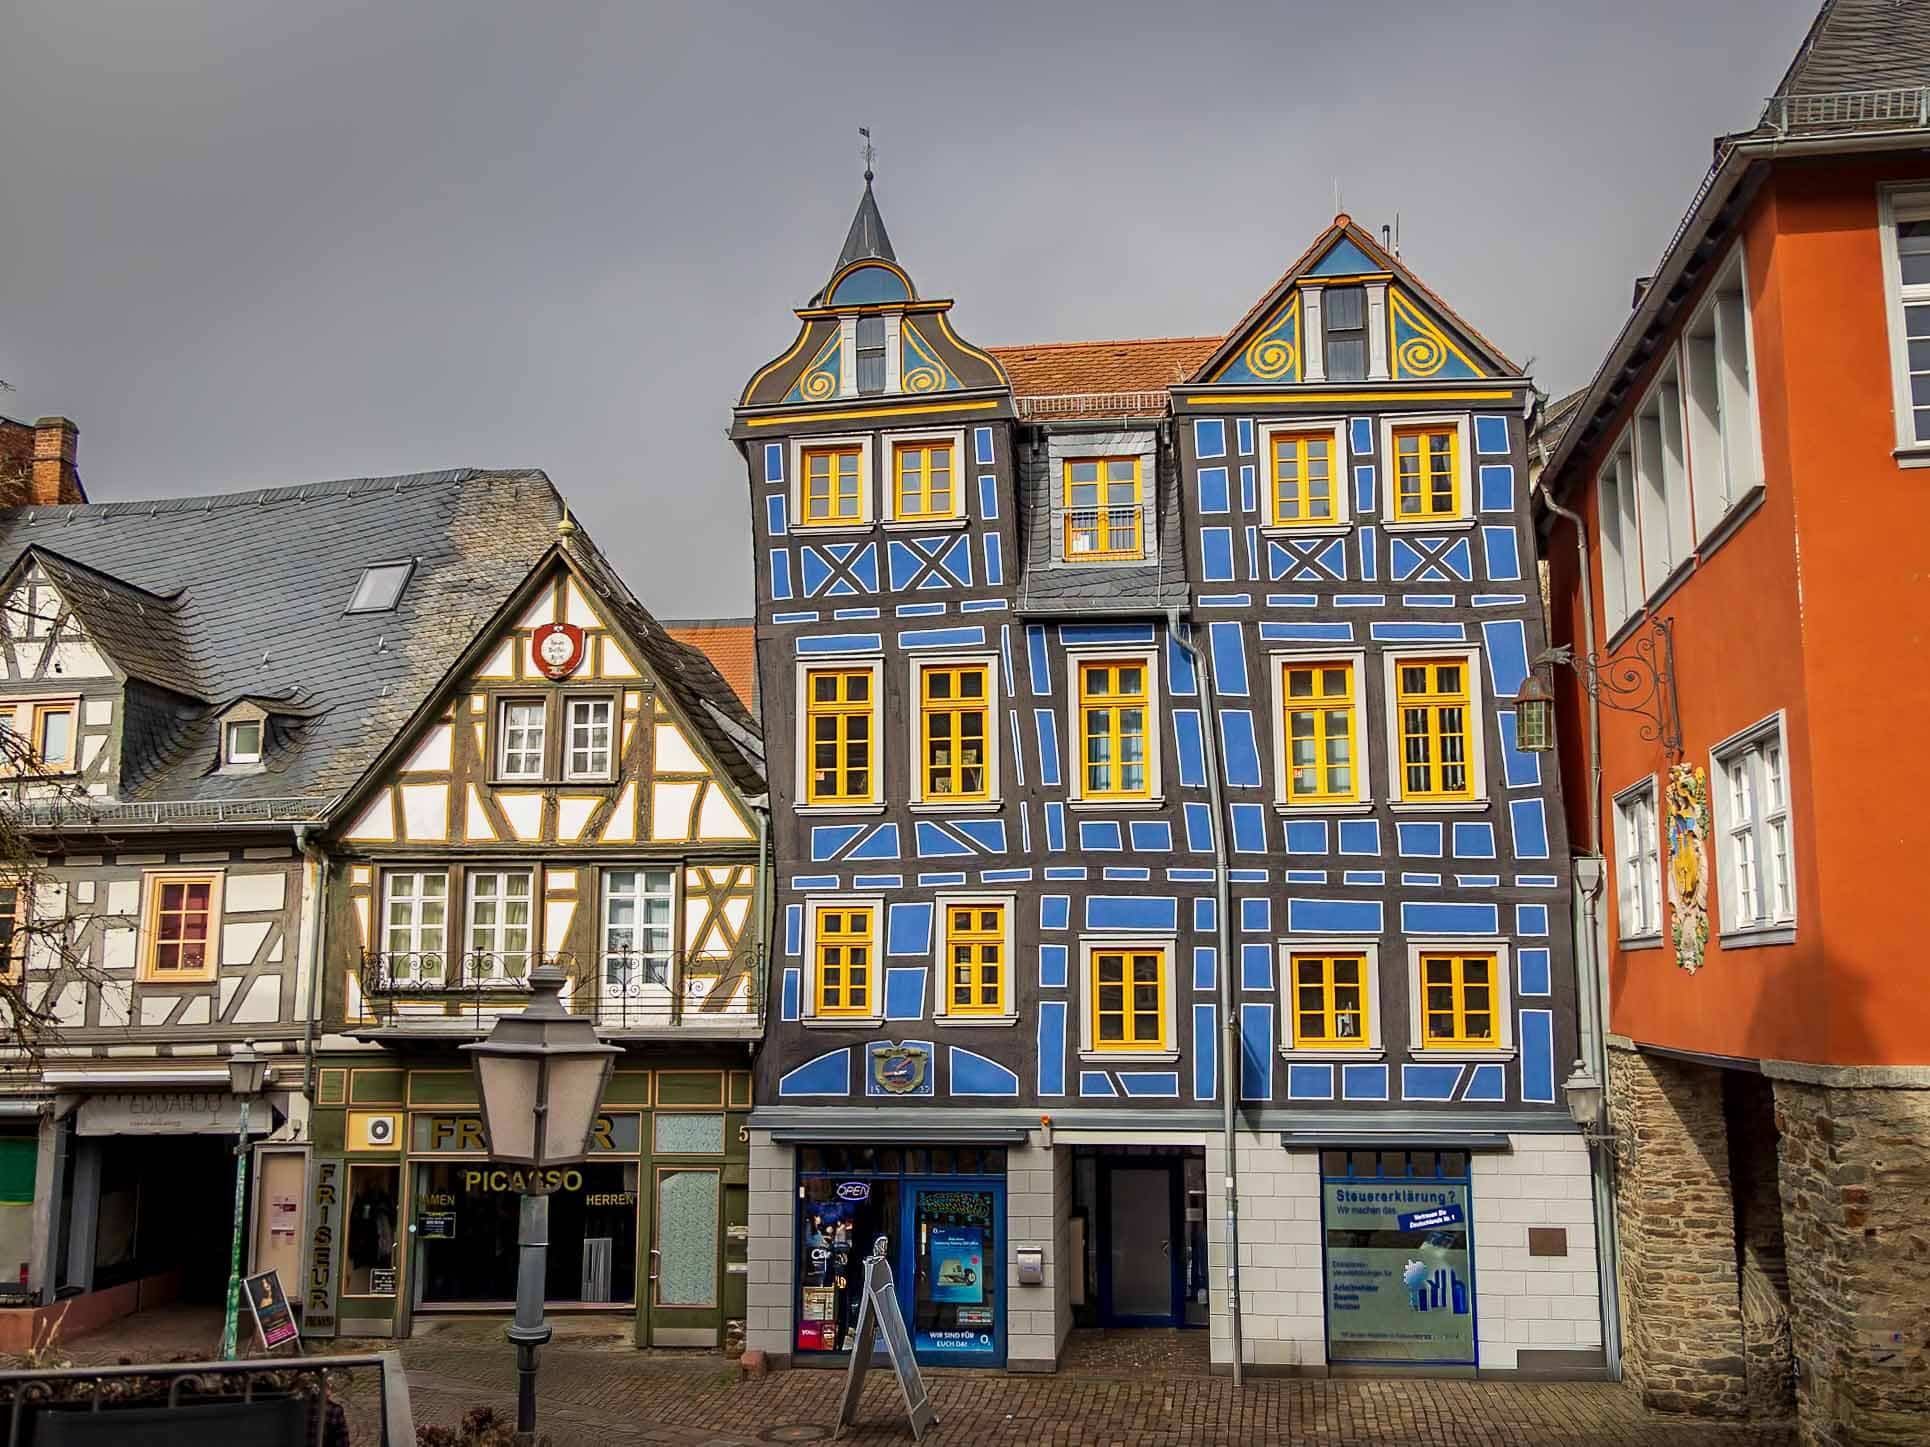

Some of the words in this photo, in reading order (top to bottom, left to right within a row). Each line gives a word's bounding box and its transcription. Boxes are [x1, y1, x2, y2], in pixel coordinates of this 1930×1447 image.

[739, 1125, 749, 1142] 5
[836, 1184, 870, 1197] OPEN
[586, 1193, 634, 1206] HERREN
[309, 1163, 336, 1311] FRISEUR
